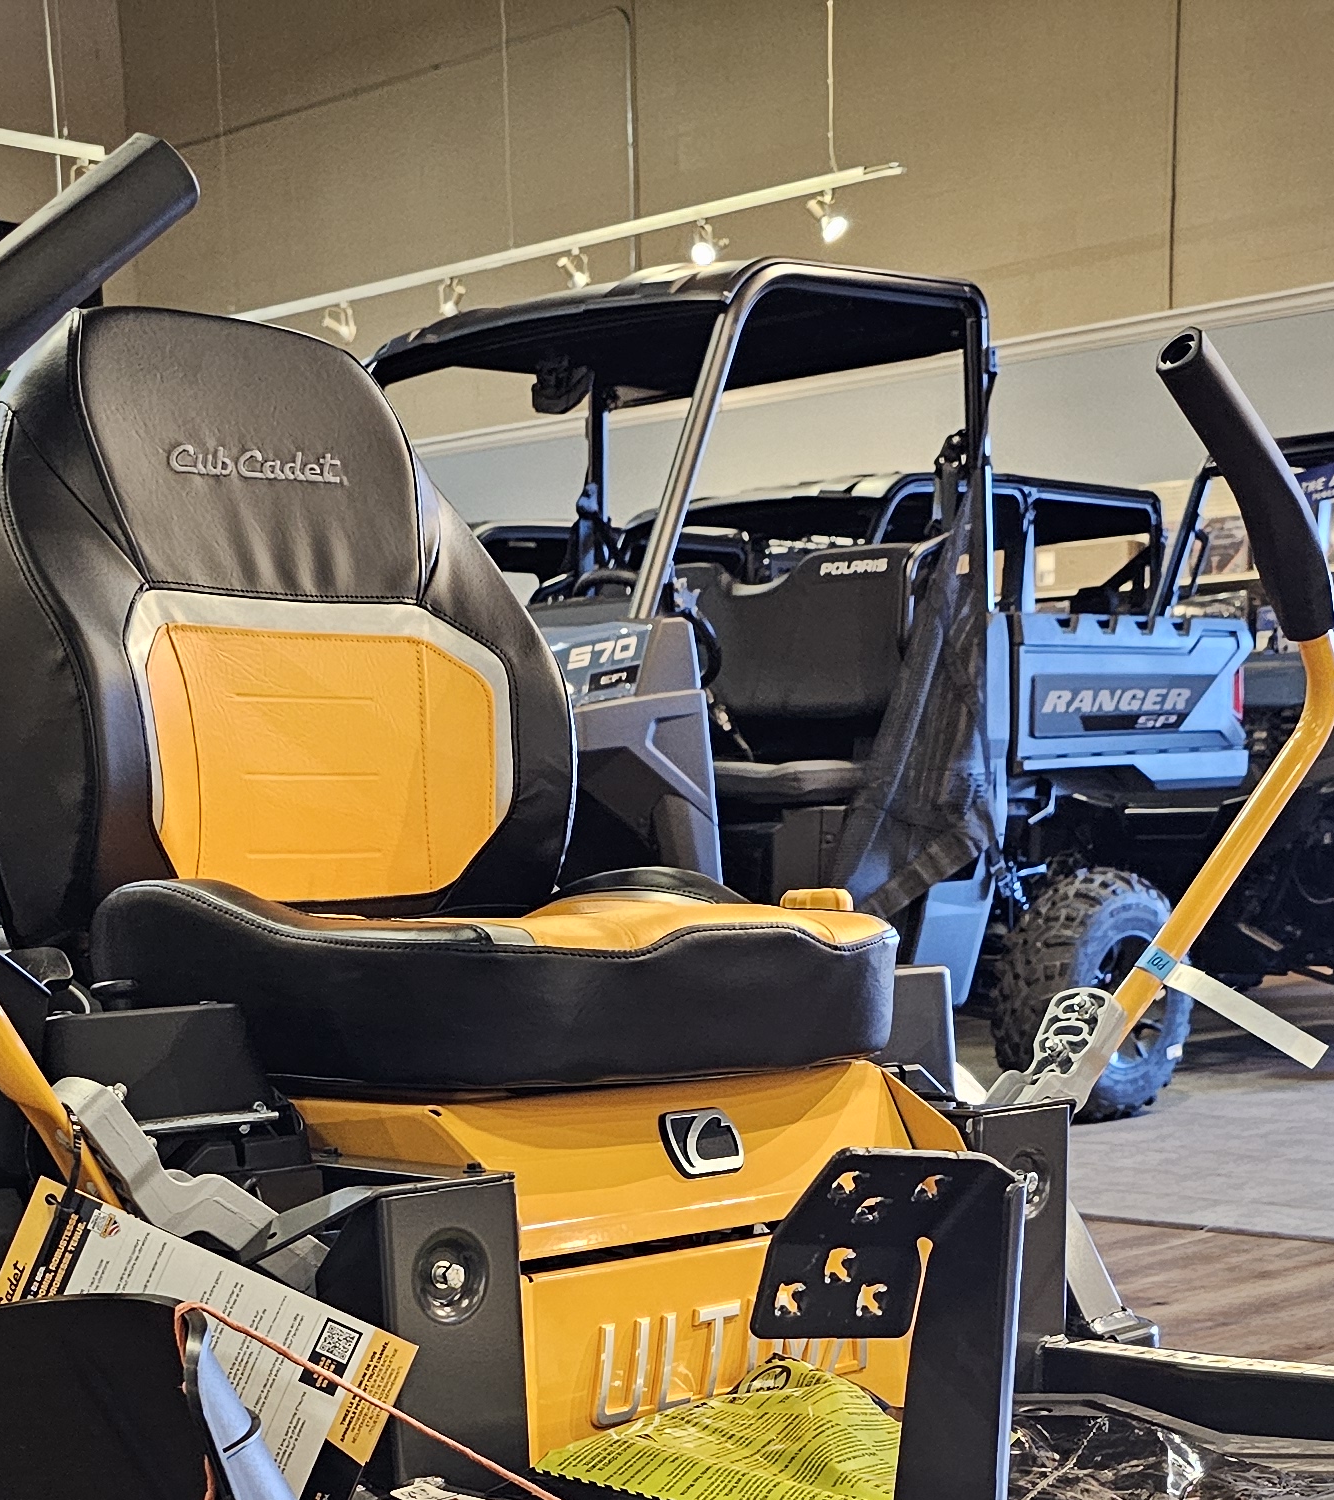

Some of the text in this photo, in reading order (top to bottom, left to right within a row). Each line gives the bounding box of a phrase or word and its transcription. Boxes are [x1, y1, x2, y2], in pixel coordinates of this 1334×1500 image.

[169, 444, 340, 484] Cub Cadet
[819, 557, 888, 577] POLARIS
[1041, 688, 1192, 713] RANGER
[1134, 714, 1178, 729] SP
[593, 1298, 868, 1429] ULT
[353, 1383, 369, 1410] PENANT
[367, 1364, 378, 1383] TOUTE
